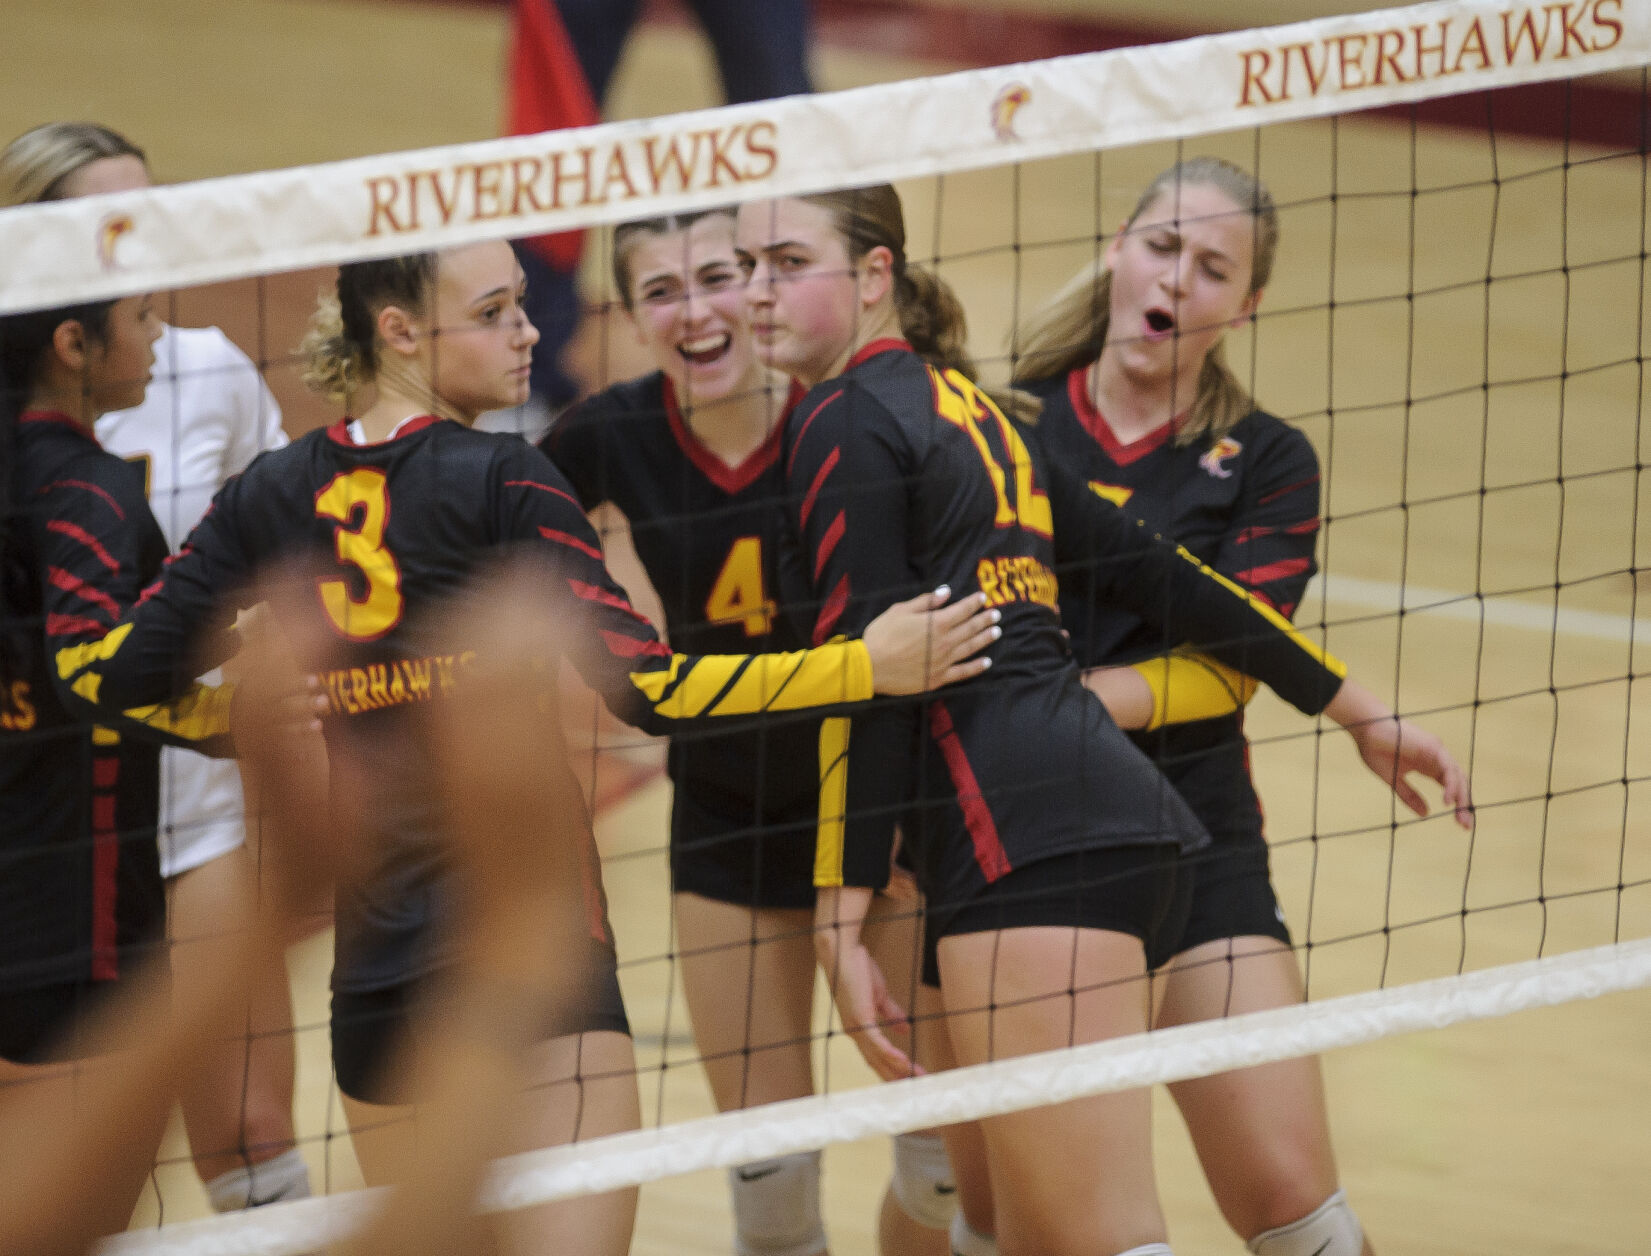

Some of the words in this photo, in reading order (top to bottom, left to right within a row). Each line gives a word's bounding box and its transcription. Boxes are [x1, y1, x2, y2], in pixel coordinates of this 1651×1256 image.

[1236, 0, 1624, 109] RIVERHAWKS
[364, 120, 780, 238] RIVERHAWKS
[314, 466, 405, 643] 3
[704, 534, 778, 638] 4
